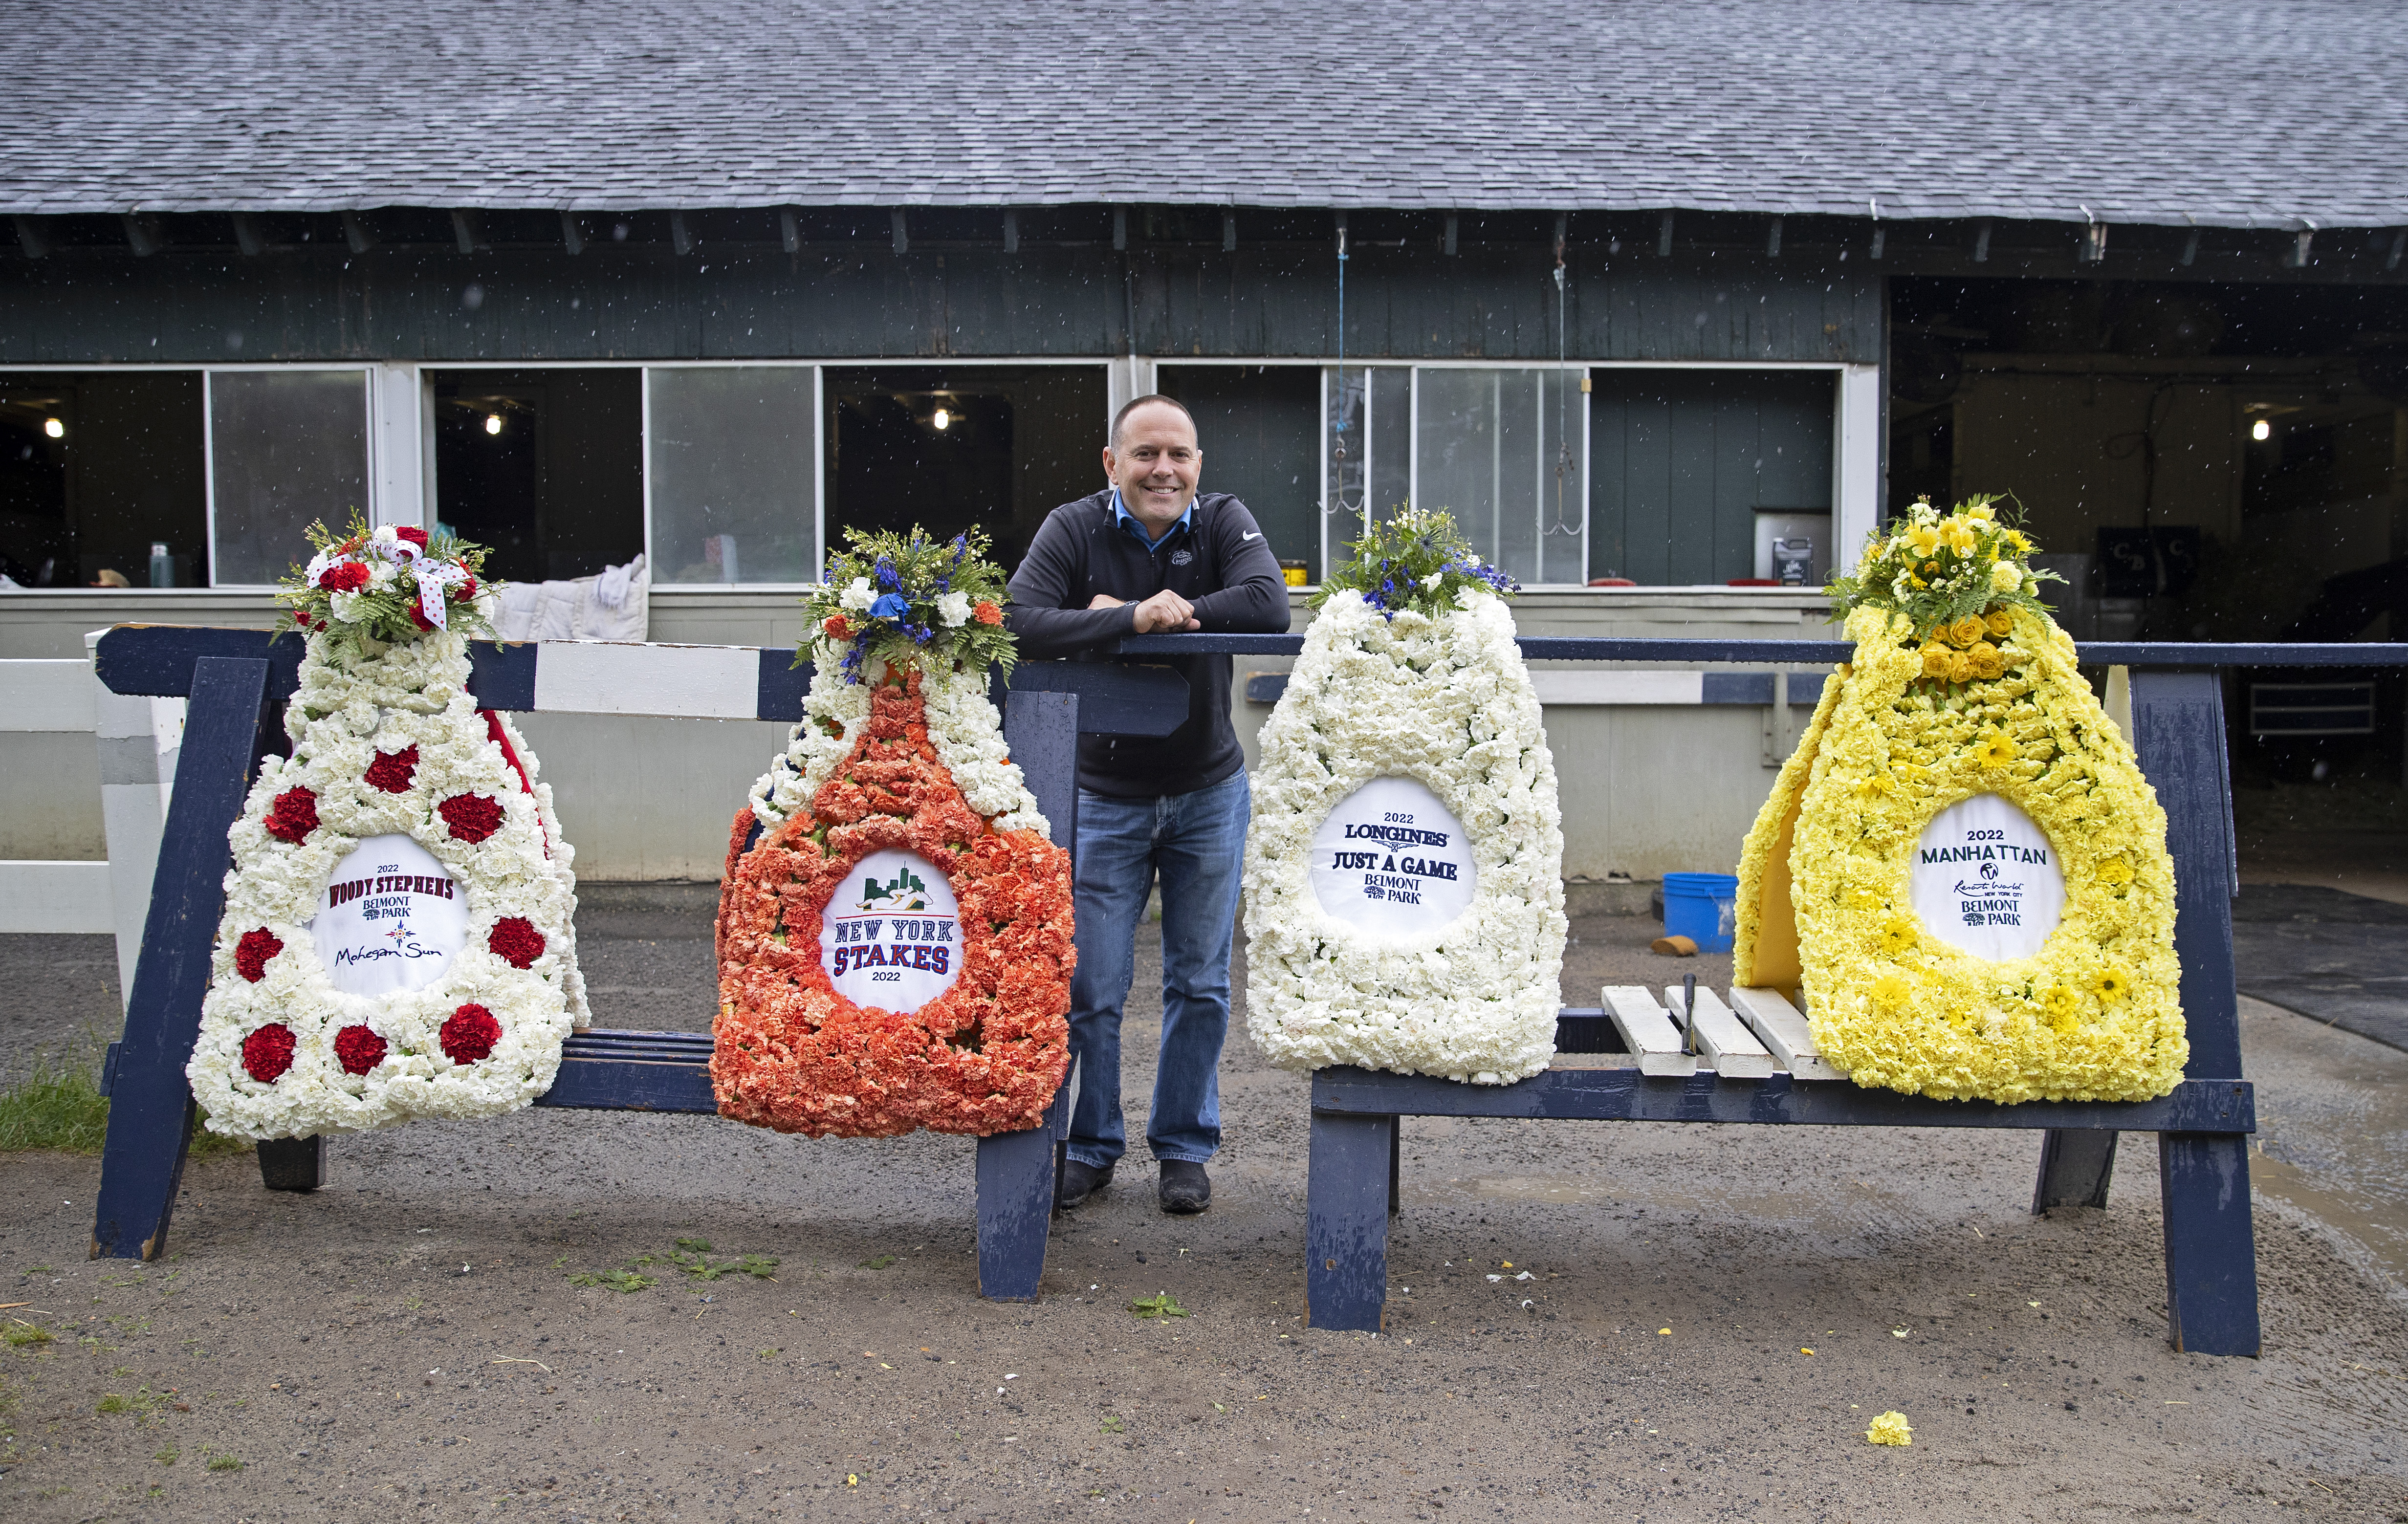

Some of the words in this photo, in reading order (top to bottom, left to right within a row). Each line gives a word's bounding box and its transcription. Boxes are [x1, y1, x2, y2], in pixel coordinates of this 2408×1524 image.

[1384, 812, 1414, 824] 2022
[1345, 824, 1448, 848] LONGINES
[1967, 830, 2004, 841] 2022
[1921, 845, 2047, 865] MANHATTAN
[377, 864, 398, 873] 2022
[1333, 852, 1378, 870] JUST
[1381, 855, 1397, 872] A
[1401, 857, 1458, 881] GAME
[1364, 873, 1422, 891] BELMONT
[1954, 880, 1990, 896] Resorts
[1992, 881, 2024, 890] World
[329, 878, 374, 909] WOODY
[376, 875, 454, 900] STEPHENS
[1388, 890, 1422, 905] PARK
[363, 896, 411, 910] BELMONT
[1961, 900, 2019, 913] BELMONT
[382, 907, 411, 918] PARK
[1988, 913, 2021, 926] PARK
[835, 919, 882, 943] NEW
[892, 920, 954, 941] YORK
[335, 946, 402, 967] Mohegan
[405, 943, 442, 958] Sun
[834, 944, 949, 977] STAKES
[872, 972, 900, 981] 2022
